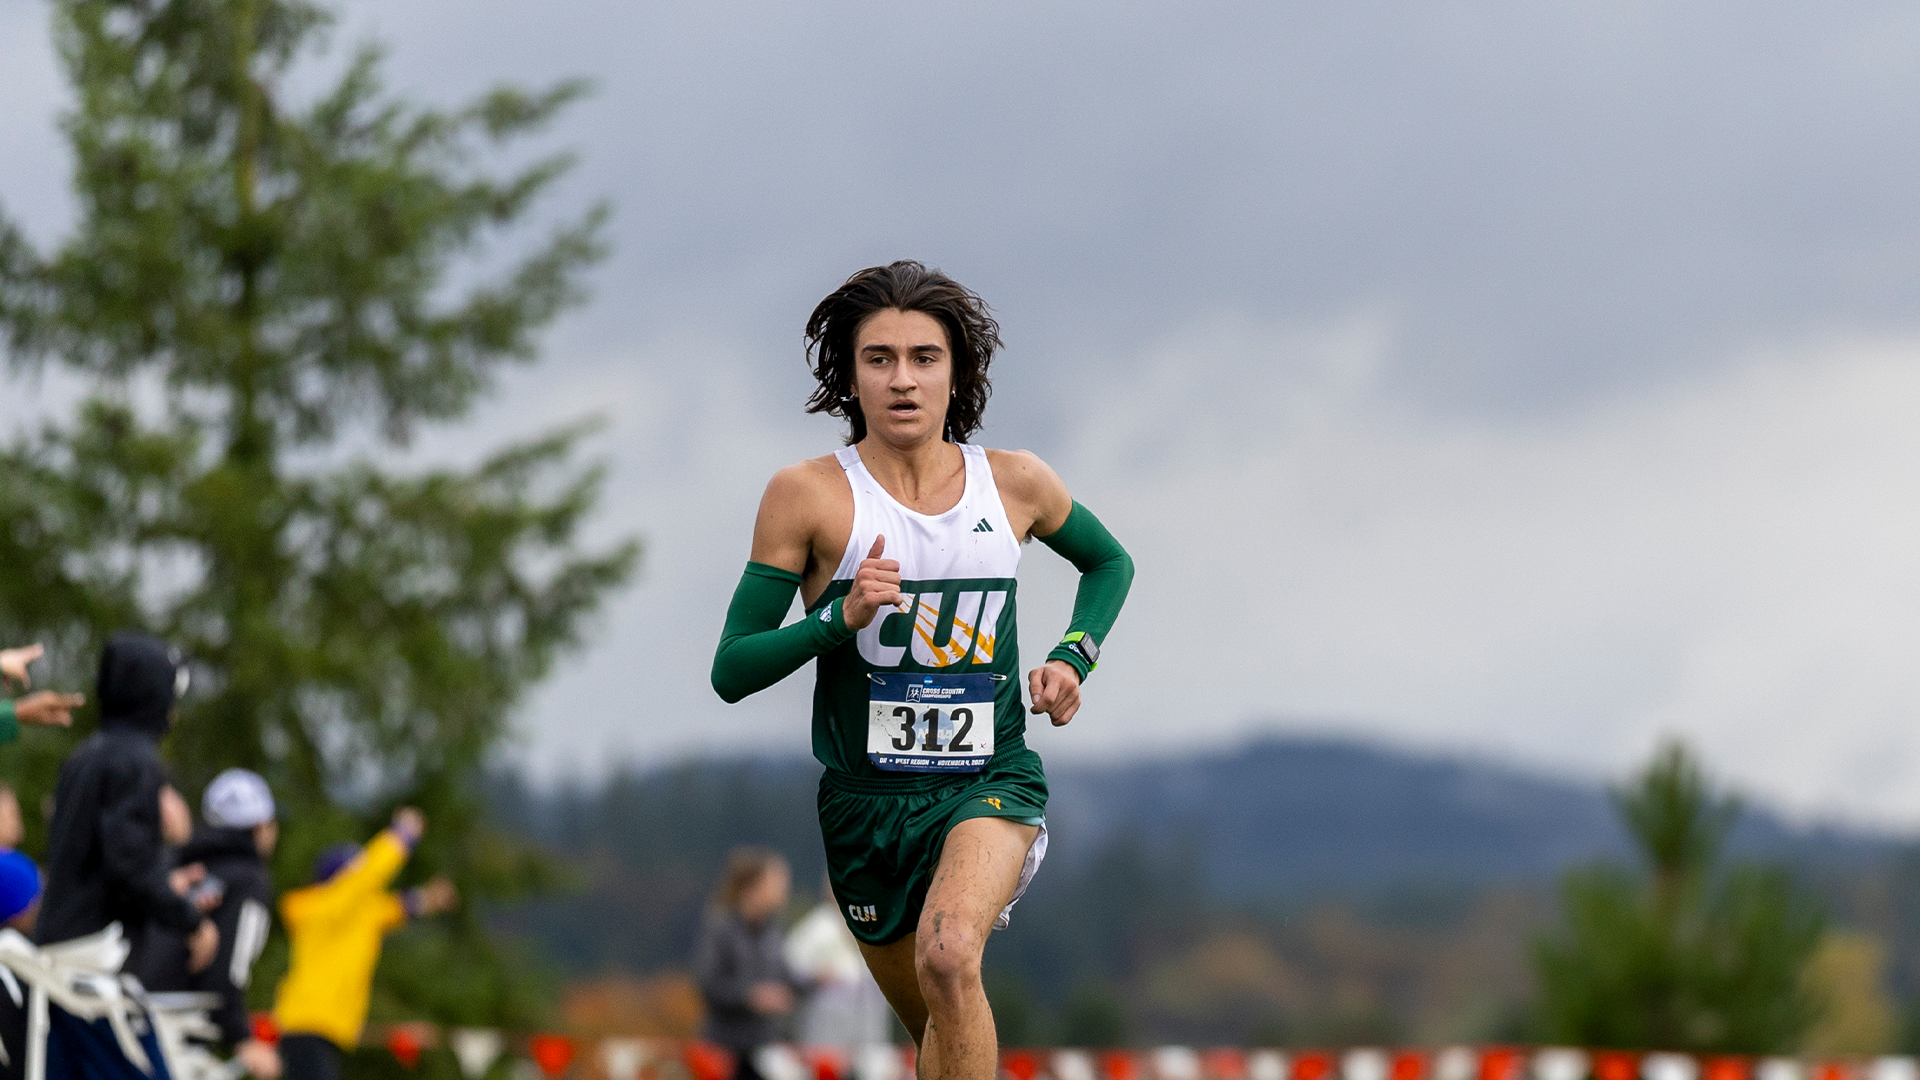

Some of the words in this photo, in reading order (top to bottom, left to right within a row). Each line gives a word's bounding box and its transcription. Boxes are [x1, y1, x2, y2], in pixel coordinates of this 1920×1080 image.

[857, 591, 1007, 667] CUI
[892, 706, 974, 752] 312
[910, 758, 930, 766] REGION
[849, 905, 877, 922] CUI
